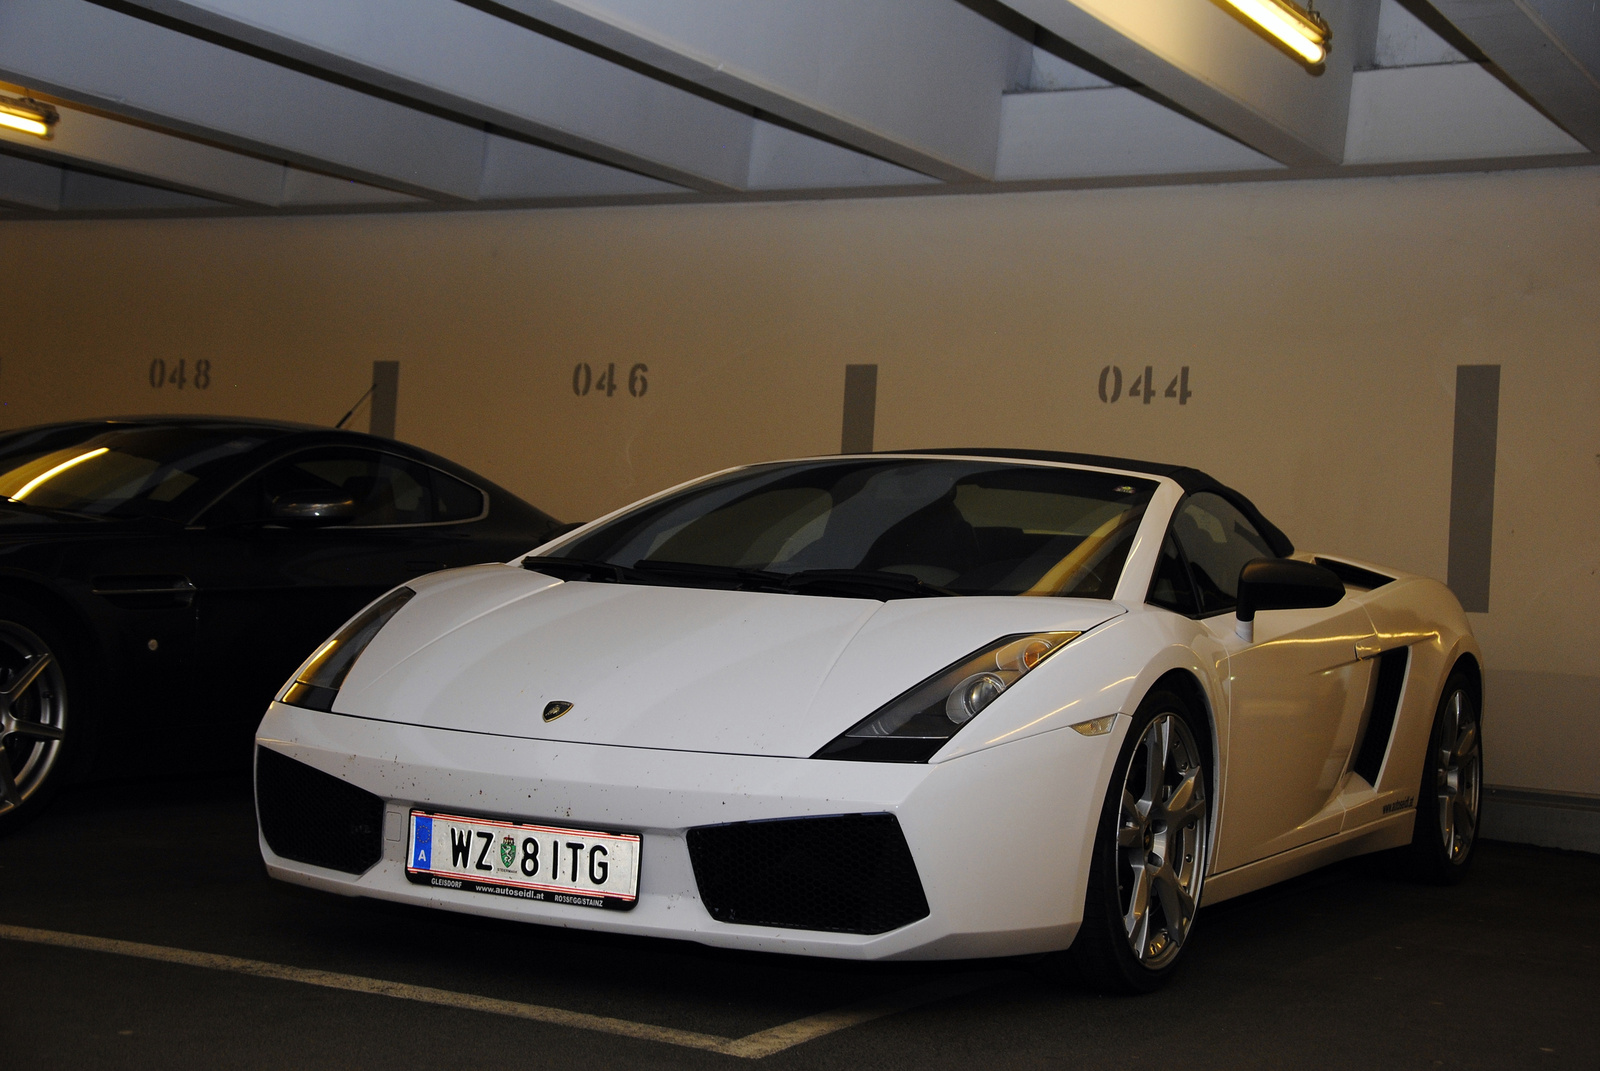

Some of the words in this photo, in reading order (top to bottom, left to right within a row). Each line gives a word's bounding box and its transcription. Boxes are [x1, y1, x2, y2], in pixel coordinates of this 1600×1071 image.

[150, 358, 211, 390] 048
[572, 362, 649, 398] 046
[1098, 365, 1193, 406] 044
[417, 850, 427, 862] A
[451, 827, 494, 871] WZ
[431, 877, 462, 889] GLEISDORF
[475, 884, 544, 900] www.autoseidl.at
